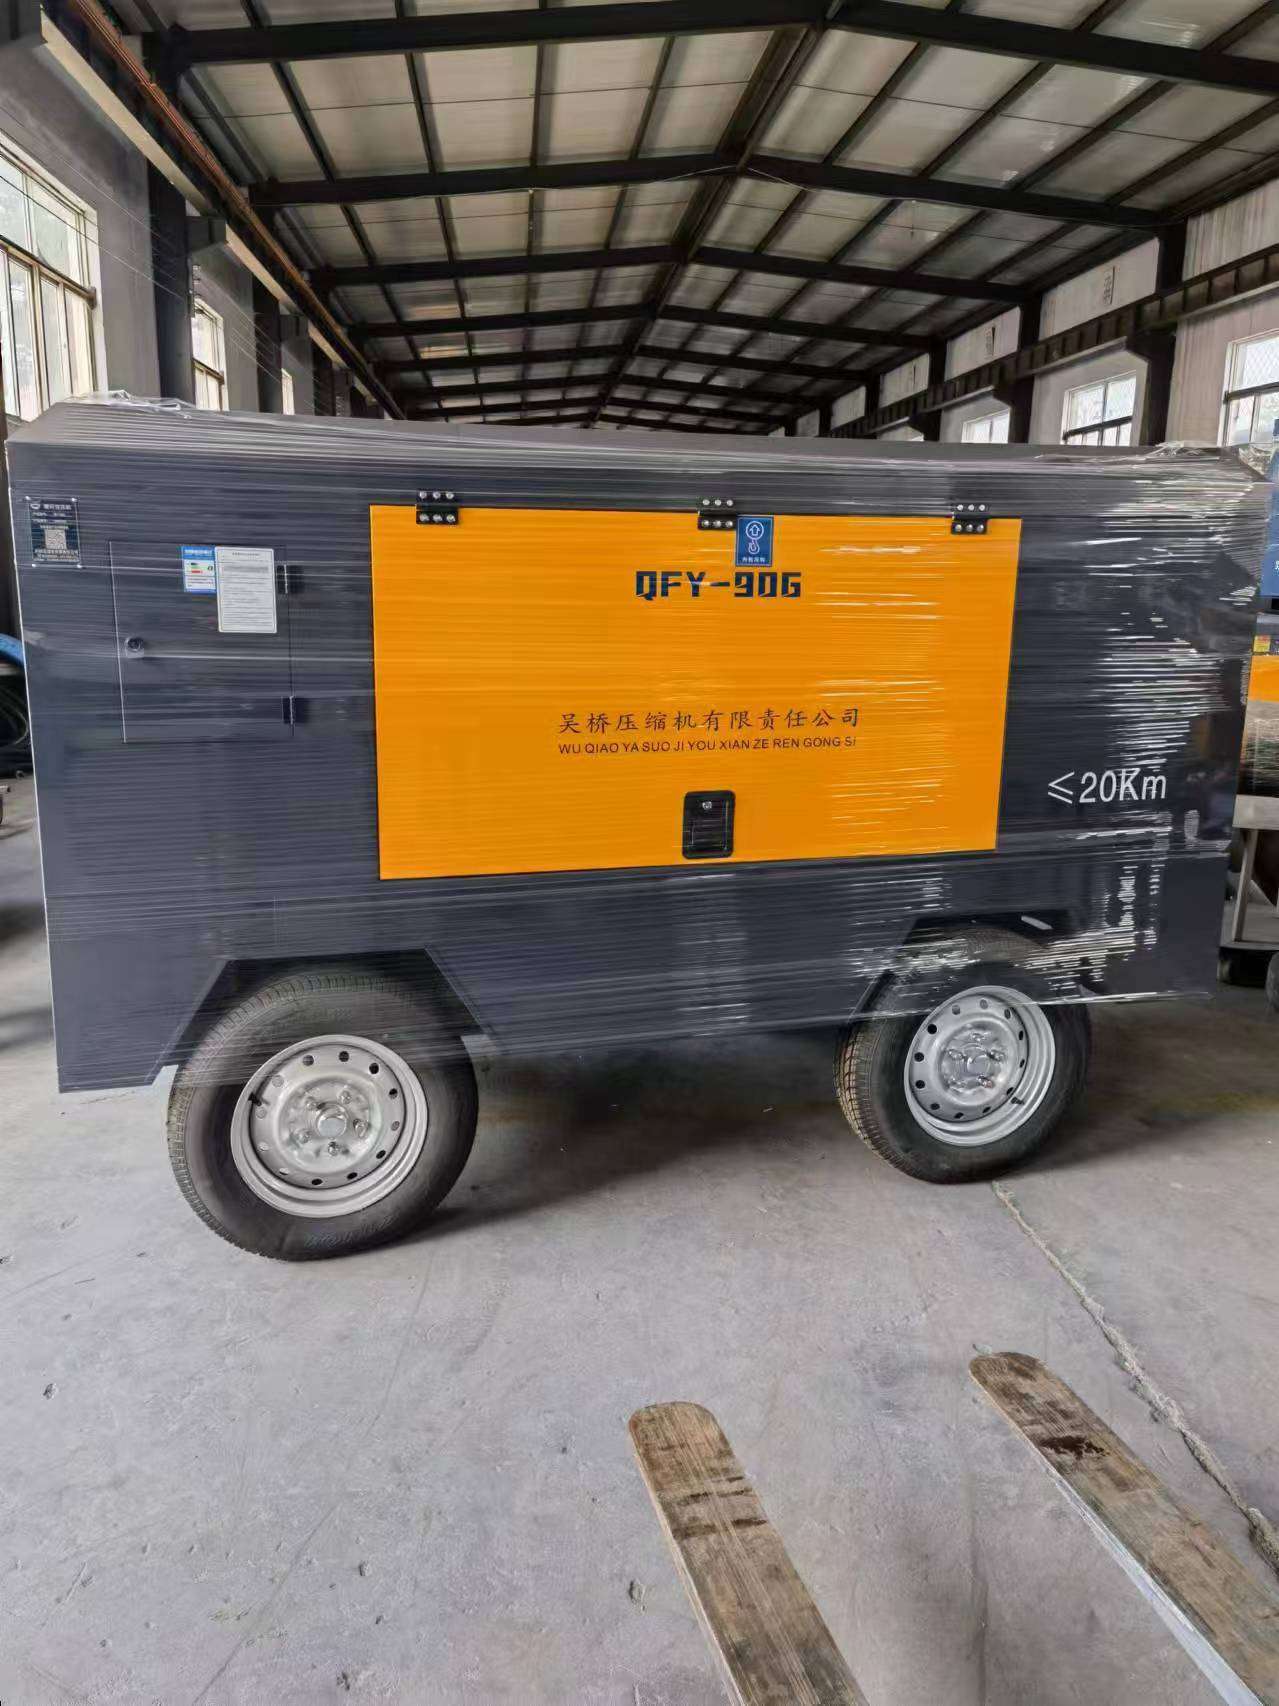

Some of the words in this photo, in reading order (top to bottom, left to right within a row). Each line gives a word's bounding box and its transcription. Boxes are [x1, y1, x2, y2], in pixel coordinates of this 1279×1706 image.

[635, 570, 802, 601] QFY-90G
[559, 708, 859, 735] 吴桥压缩机有限责任公司
[558, 743, 582, 755] WU
[584, 742, 620, 754] QIAO
[622, 741, 640, 753] YA
[642, 741, 671, 753] SUO
[673, 740, 685, 752] JI
[687, 740, 716, 751] YOU
[719, 739, 750, 750] XIAN
[752, 738, 770, 749] ZE
[772, 738, 800, 749] REN
[803, 737, 841, 748] GONG
